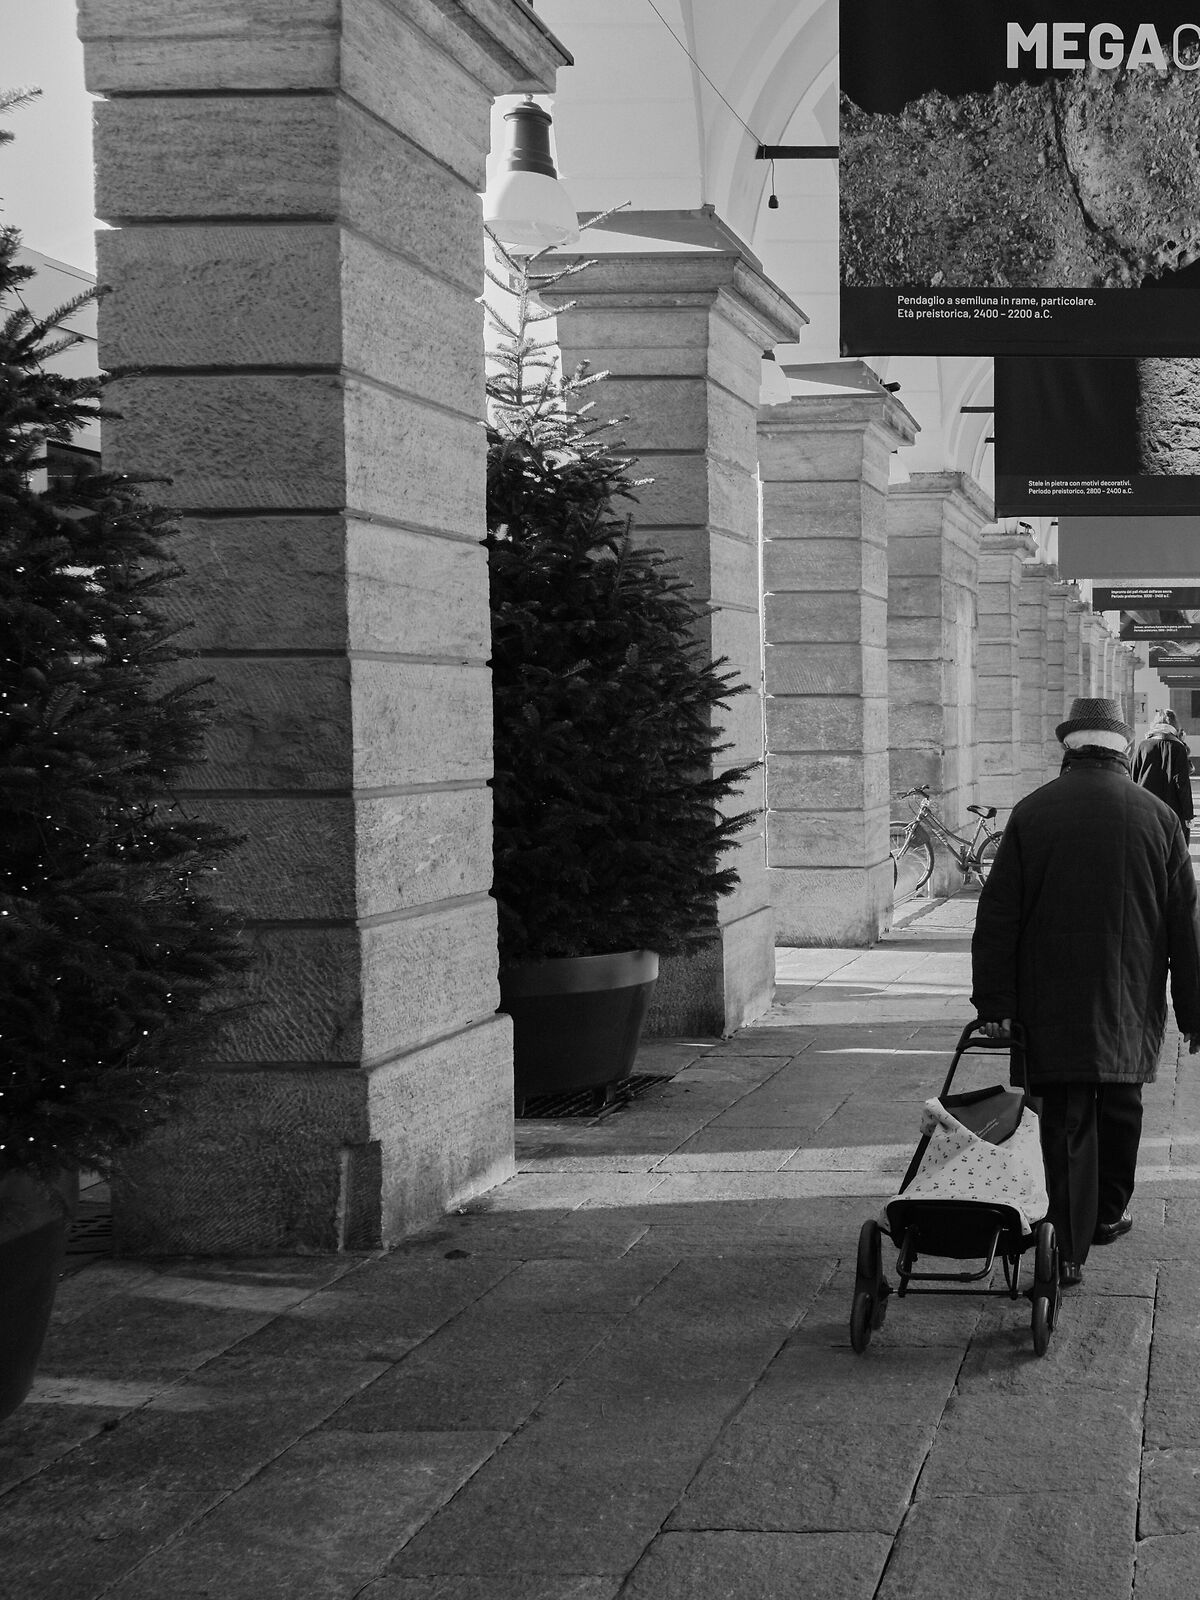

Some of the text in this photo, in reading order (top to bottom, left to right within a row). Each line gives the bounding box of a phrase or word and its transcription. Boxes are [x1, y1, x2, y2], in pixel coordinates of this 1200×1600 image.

[897, 295, 1097, 308] Pendaglio a semiluna in rame, particolare.
[897, 308, 915, 318] Età
[916, 308, 972, 320] preistorica,
[973, 308, 999, 319] 2400
[1007, 308, 1033, 319] 2200
[1034, 309, 1053, 319] a.C.
[1044, 479, 1051, 487] in
[1051, 479, 1069, 488] pietra
[1081, 479, 1100, 487] motivi
[1100, 479, 1132, 487] decorativi.
[1028, 487, 1052, 495] Periodo
[1052, 487, 1086, 496] preistorico,
[1086, 487, 1102, 495] 2800
[1106, 487, 1122, 495] 2400
